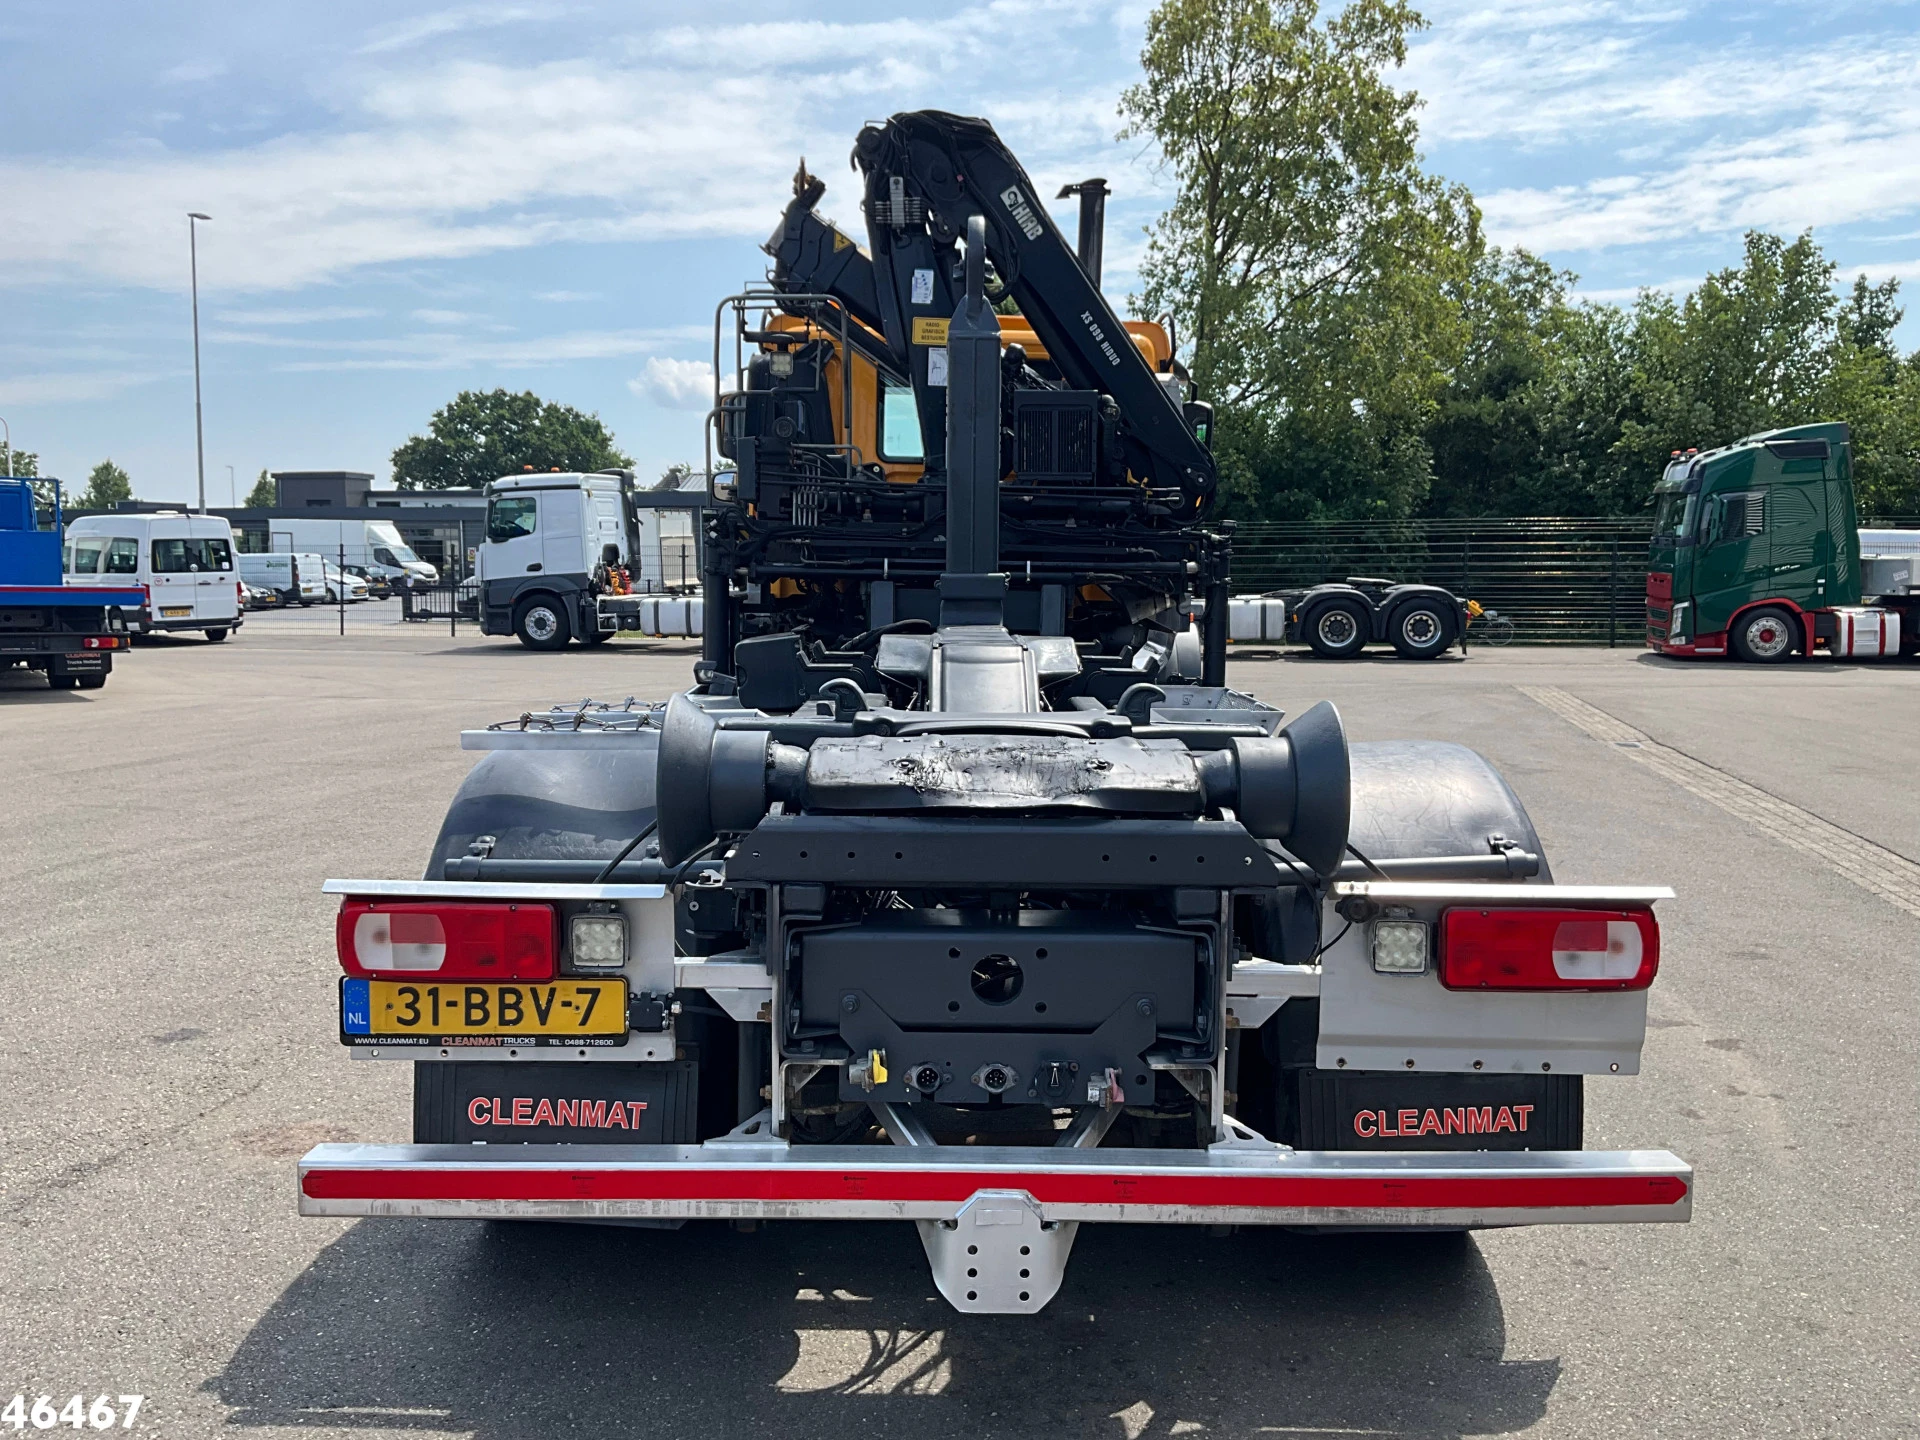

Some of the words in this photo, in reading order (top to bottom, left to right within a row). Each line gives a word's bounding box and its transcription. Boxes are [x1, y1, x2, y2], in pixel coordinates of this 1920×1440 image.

[1012, 203, 1043, 240] HIAB
[1080, 310, 1094, 325] XS
[1089, 323, 1105, 342] 099
[1100, 341, 1121, 366] HIDUO
[348, 1012, 367, 1025] NL
[396, 986, 602, 1027] 31-BBV-7
[354, 1037, 429, 1045] WWW.CLEANMAT.EU
[467, 1096, 648, 1130] CLEANMAT
[1353, 1104, 1535, 1138] CLEANMAT
